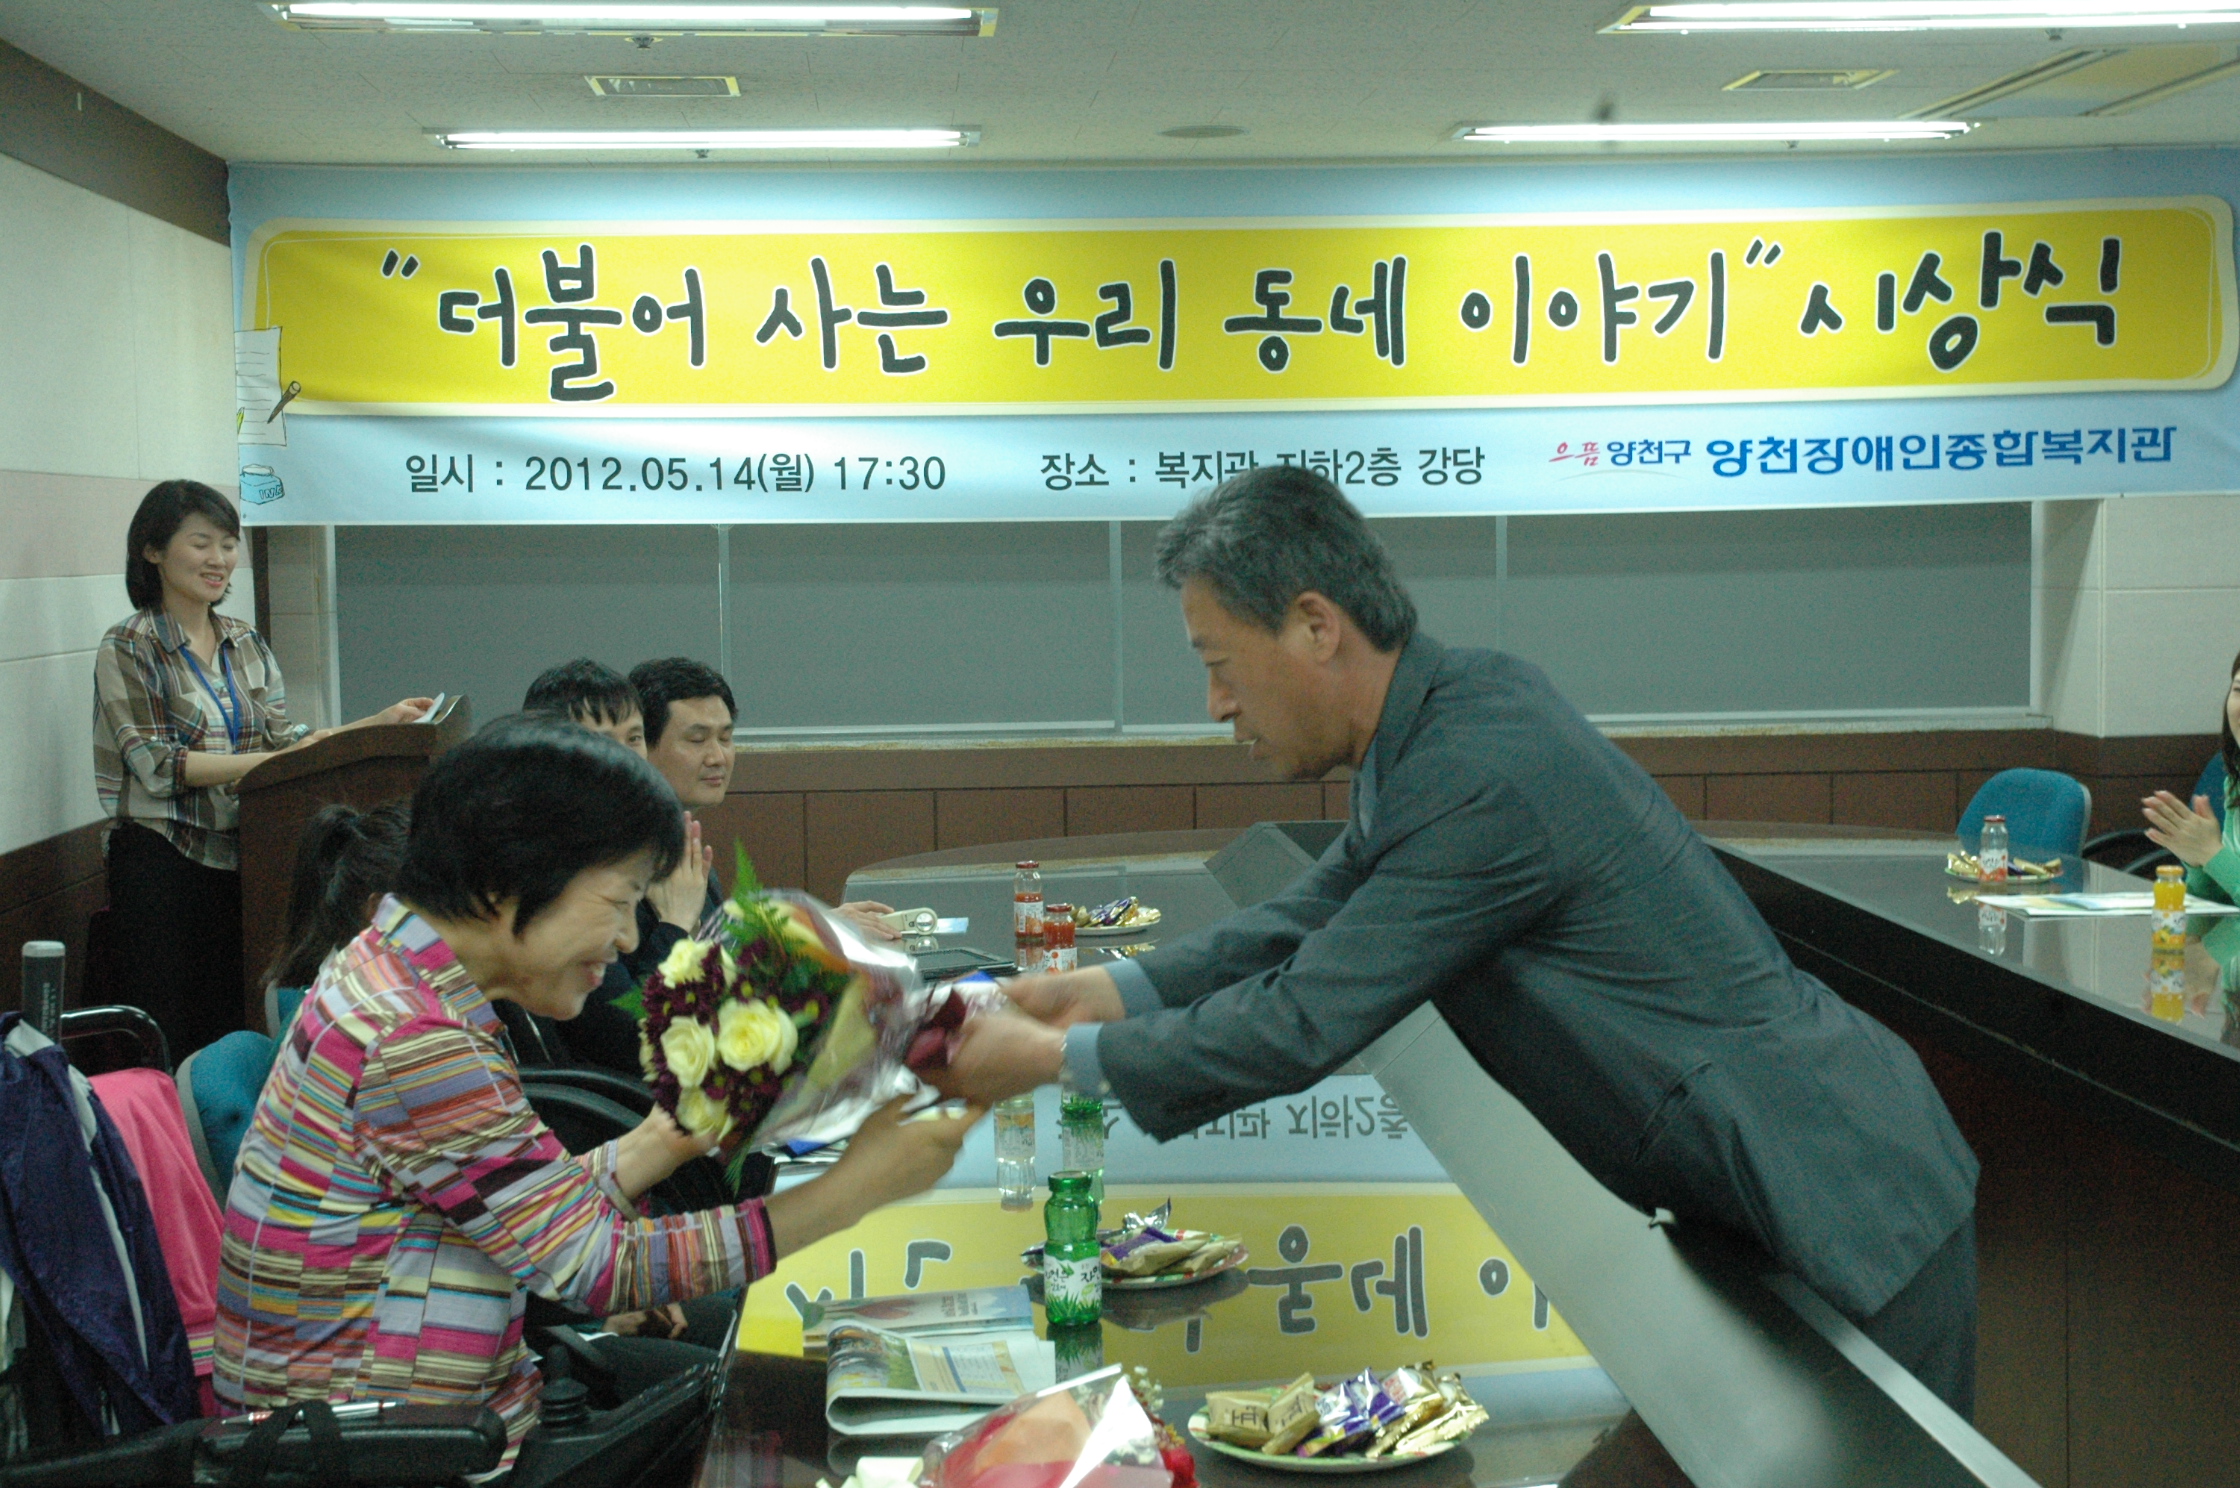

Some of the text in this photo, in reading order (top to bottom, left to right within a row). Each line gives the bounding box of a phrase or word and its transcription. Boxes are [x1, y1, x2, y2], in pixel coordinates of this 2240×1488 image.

[756, 257, 949, 374] 사는
[994, 259, 1177, 371] 우리
[1223, 255, 1407, 372] 동네
[405, 454, 474, 493] 일시
[525, 453, 815, 493] 2012.05.14(월)
[834, 456, 946, 491] 17:30
[1040, 453, 1110, 491] 장소
[1418, 446, 1486, 486] 강당
[1606, 438, 1692, 467] 양천구
[1705, 425, 2179, 478] 양천장애인종합복지관
